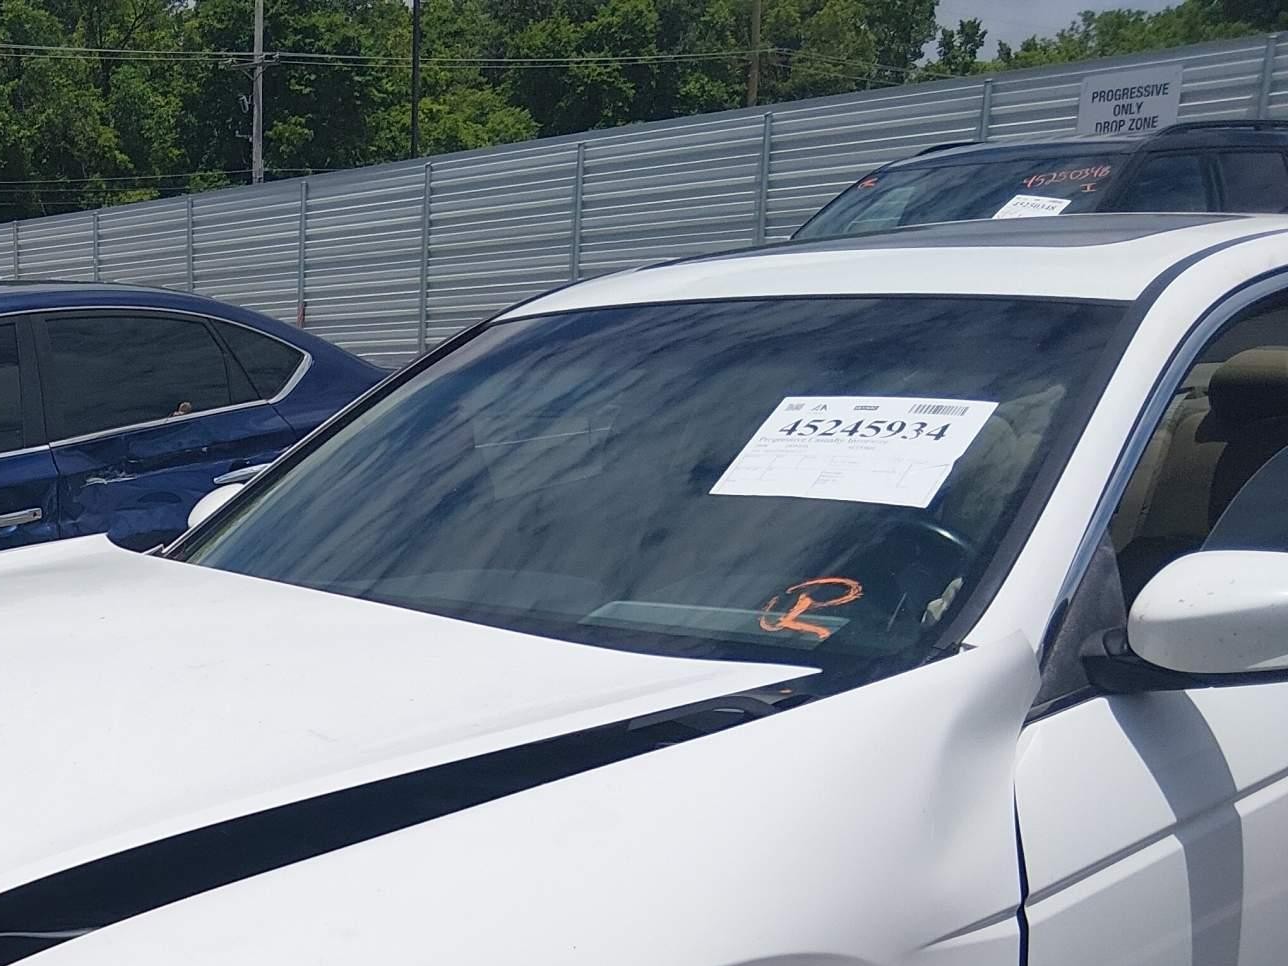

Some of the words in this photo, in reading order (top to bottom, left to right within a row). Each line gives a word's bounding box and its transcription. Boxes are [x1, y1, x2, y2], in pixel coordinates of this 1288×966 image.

[1092, 82, 1170, 103] PROGRESSIVE
[1113, 101, 1144, 117] ONLY
[1095, 119, 1126, 133] DROP
[1128, 115, 1159, 131] ZONE
[1023, 165, 1111, 189] 45250348
[778, 418, 952, 441] 45245934
